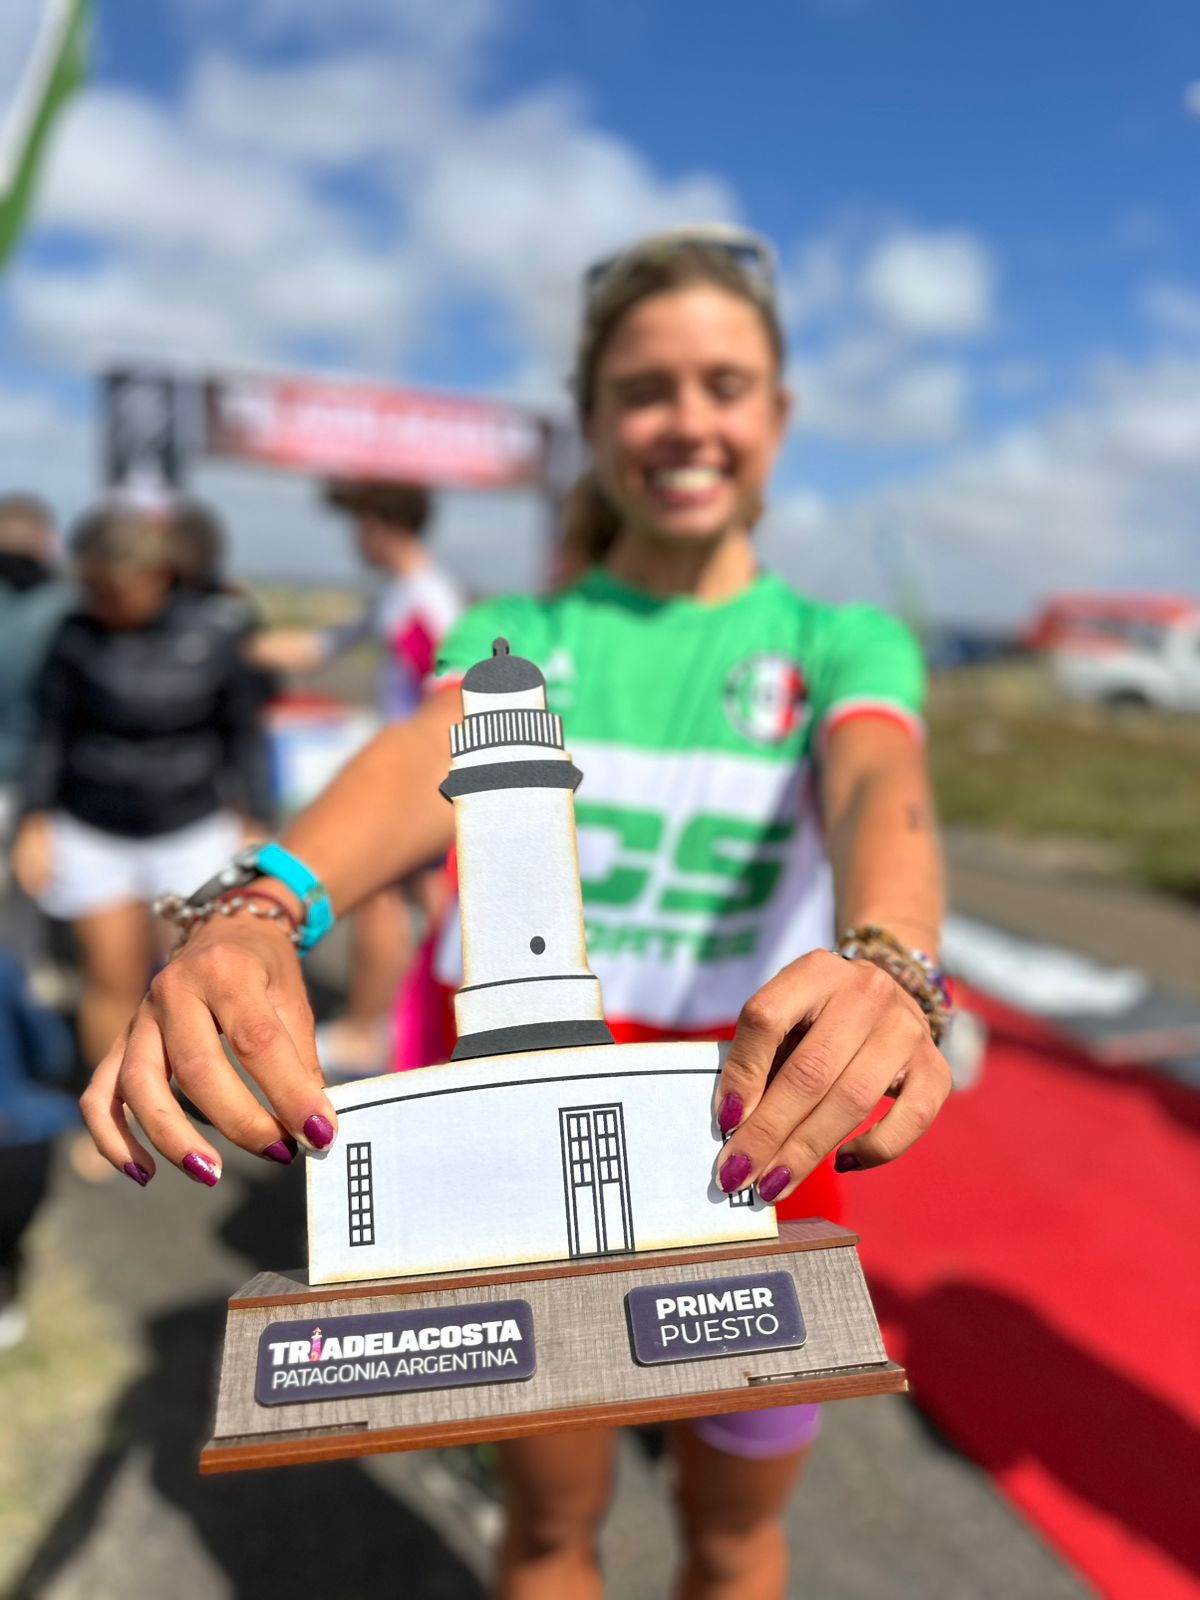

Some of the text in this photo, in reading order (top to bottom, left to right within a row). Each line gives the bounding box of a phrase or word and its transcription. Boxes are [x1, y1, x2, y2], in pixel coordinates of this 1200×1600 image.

[656, 1287, 775, 1320] PRIMER
[660, 1313, 779, 1347] PUESTO
[272, 1348, 518, 1390] PATAGONIA ARGENTINA
